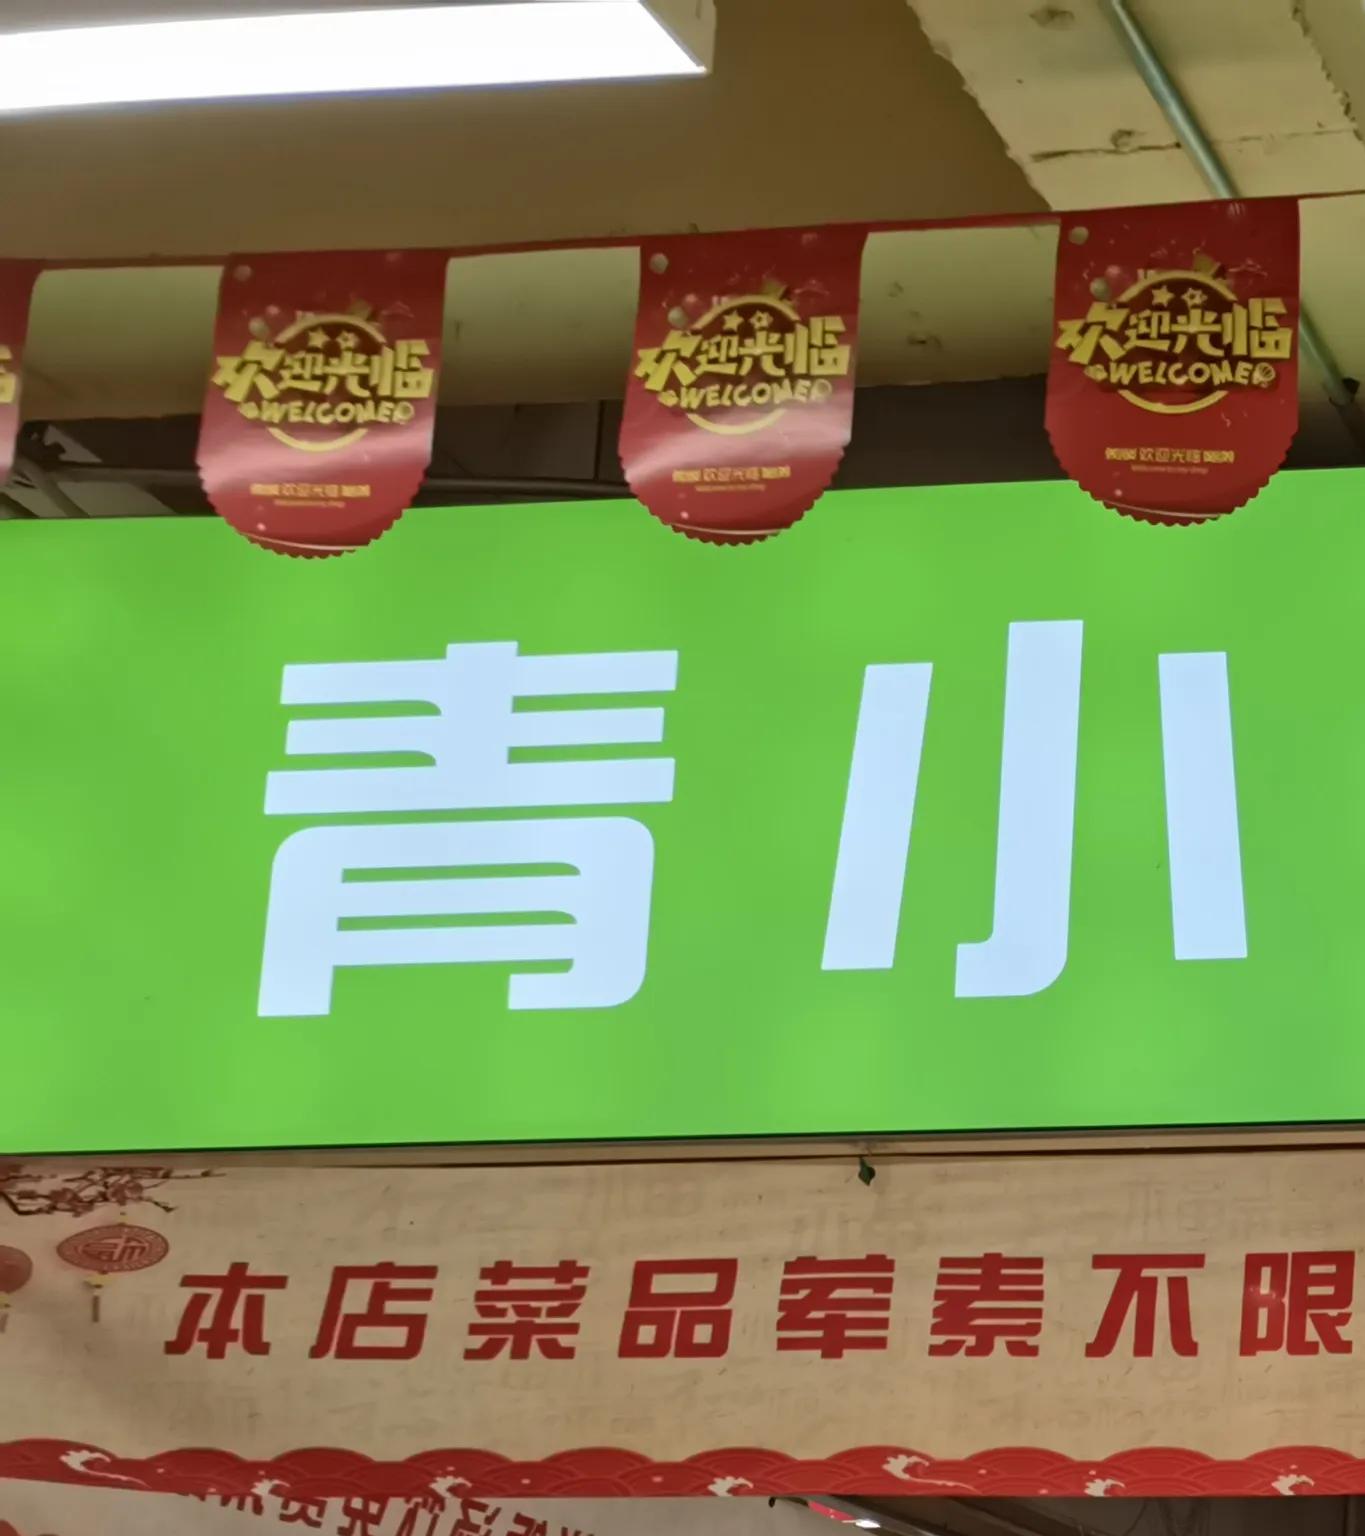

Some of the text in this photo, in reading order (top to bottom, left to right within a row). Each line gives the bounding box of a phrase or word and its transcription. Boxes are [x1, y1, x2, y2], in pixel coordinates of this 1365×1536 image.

[634, 315, 850, 391] 欢迎光临
[1054, 297, 1293, 365] 欢迎光临
[211, 339, 434, 402] 欢迎光临
[680, 378, 816, 409] WELCOME
[1109, 360, 1253, 385] WELCOME
[260, 400, 397, 424] WELCOME
